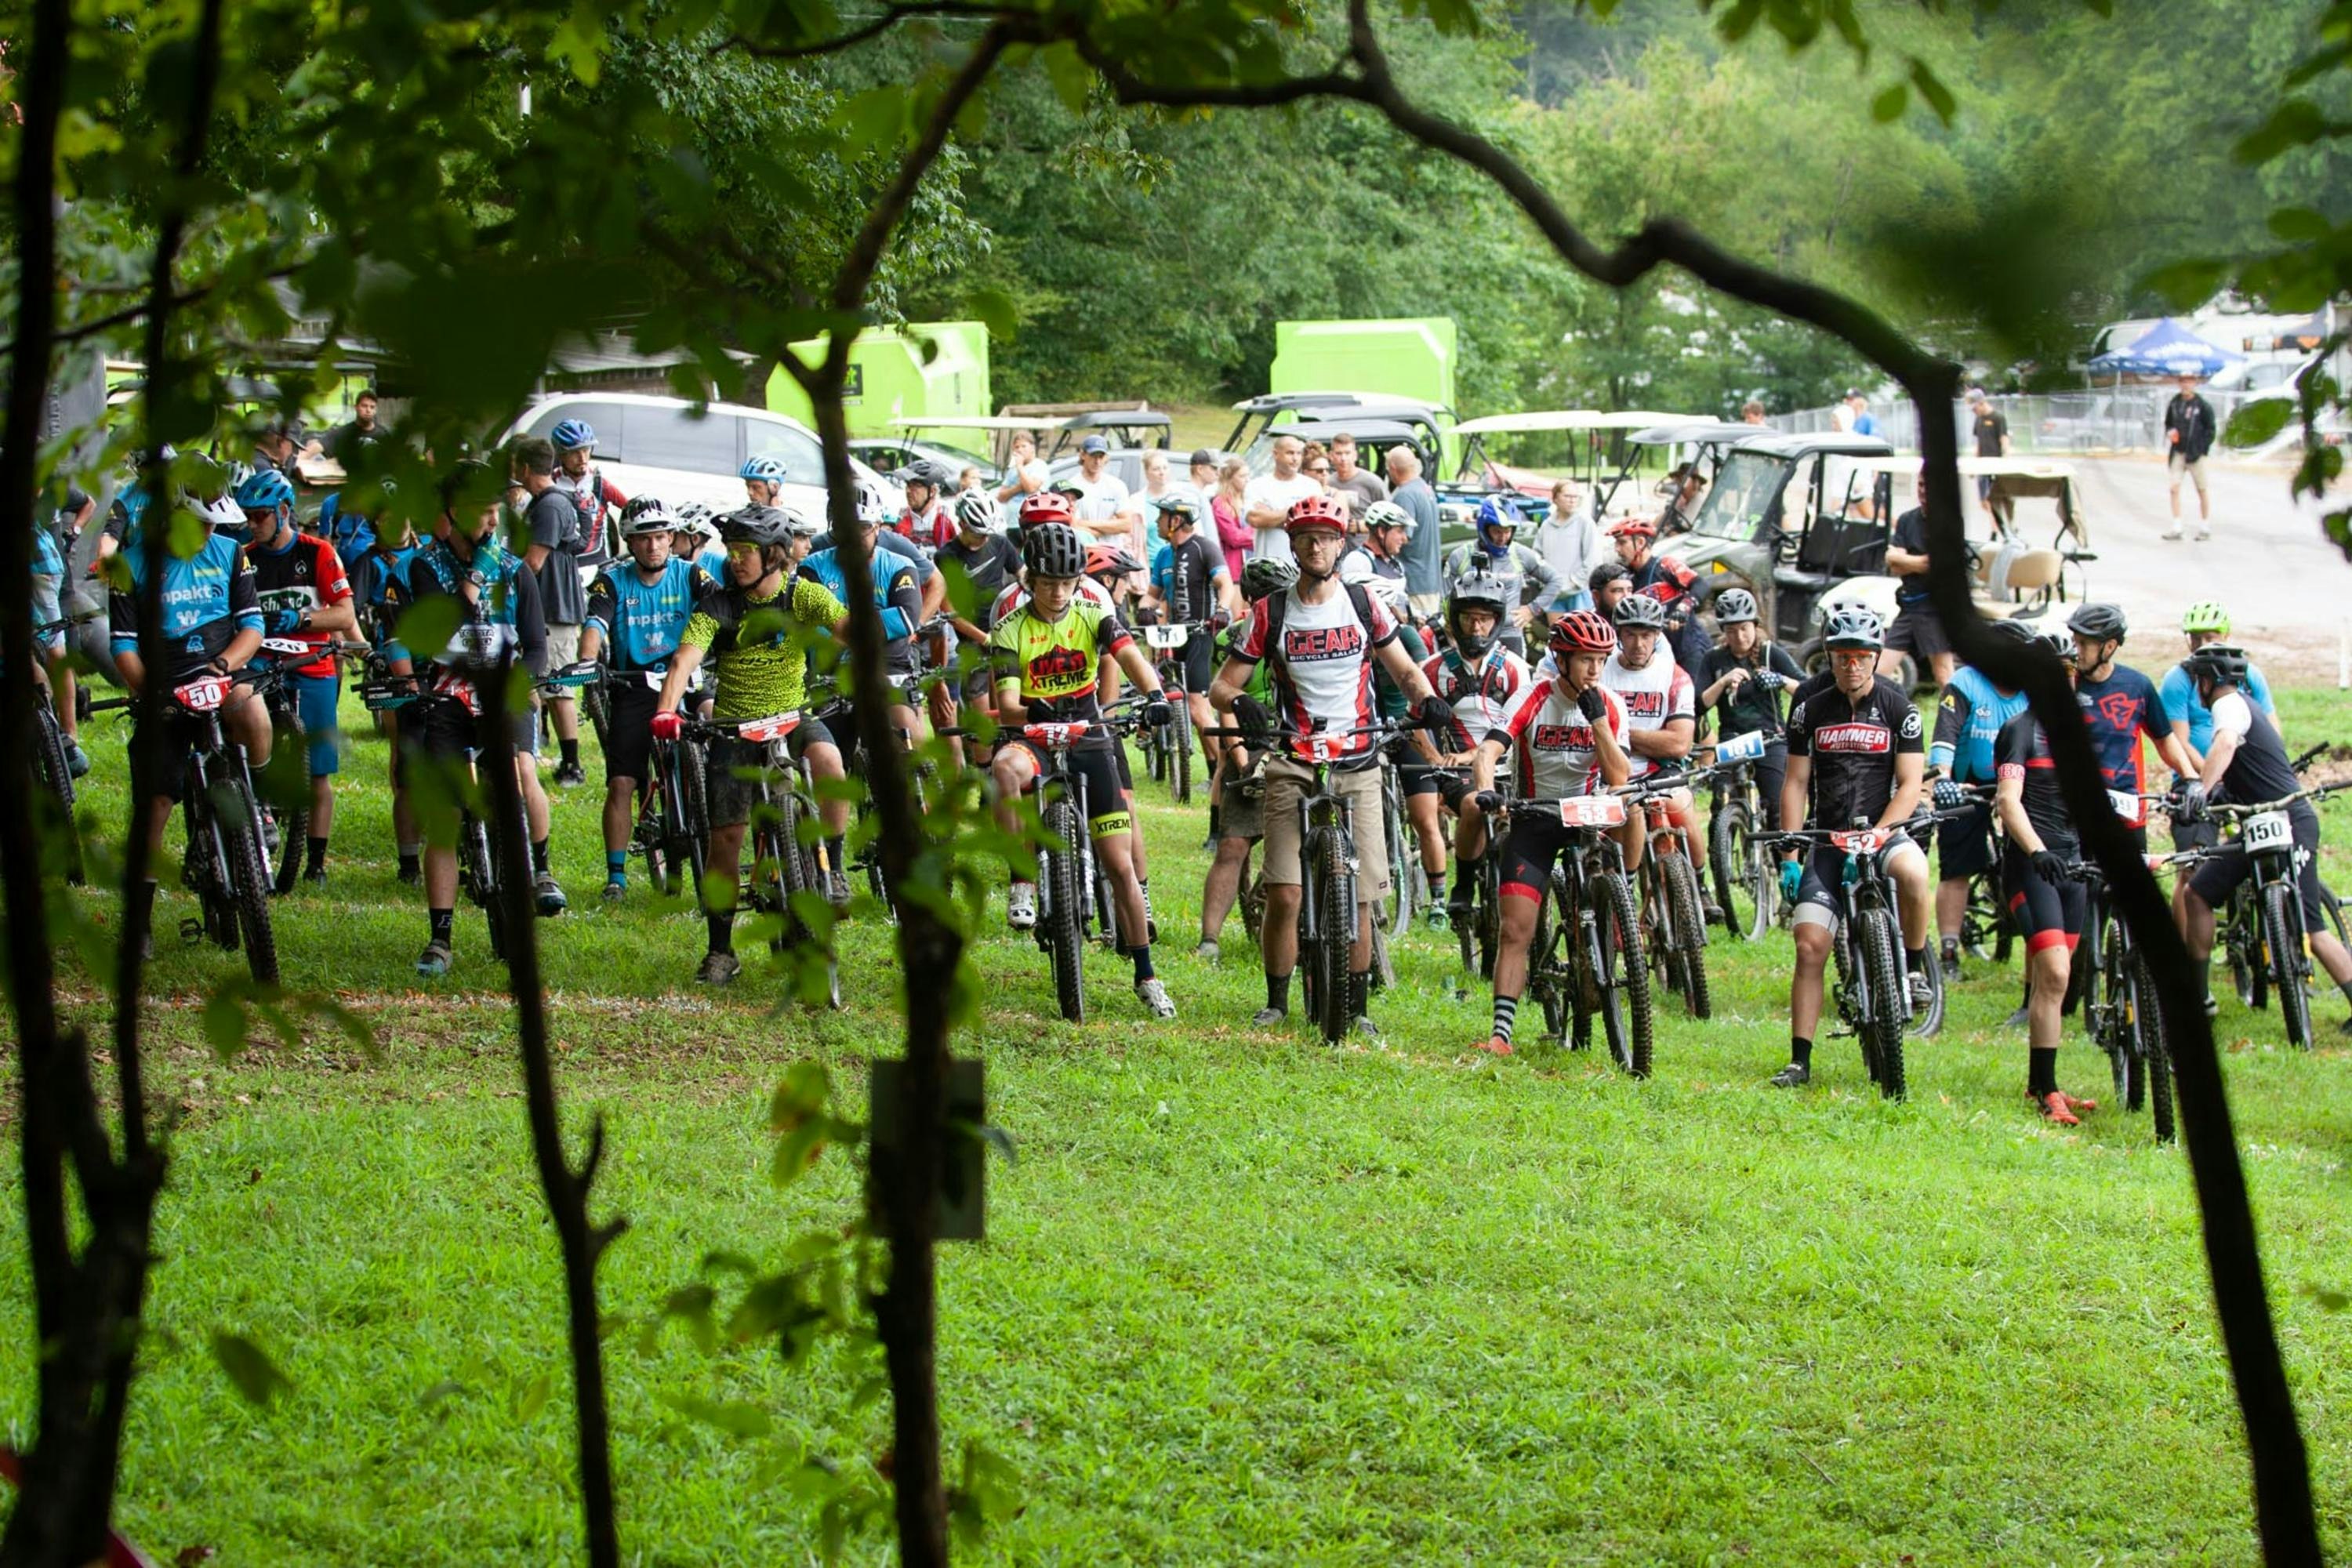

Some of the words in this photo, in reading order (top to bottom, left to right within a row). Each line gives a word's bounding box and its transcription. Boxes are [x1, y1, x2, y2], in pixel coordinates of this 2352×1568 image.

[1175, 561, 1191, 625] MOTION
[1287, 626, 1360, 655] GEAR
[1031, 670, 1089, 690] XTREME
[188, 684, 222, 706] 50
[1819, 728, 1886, 744] HAMMER
[1312, 740, 1330, 760] 5
[1578, 805, 1606, 822] 53
[2247, 821, 2283, 843] 150
[1846, 833, 1877, 852] 52
